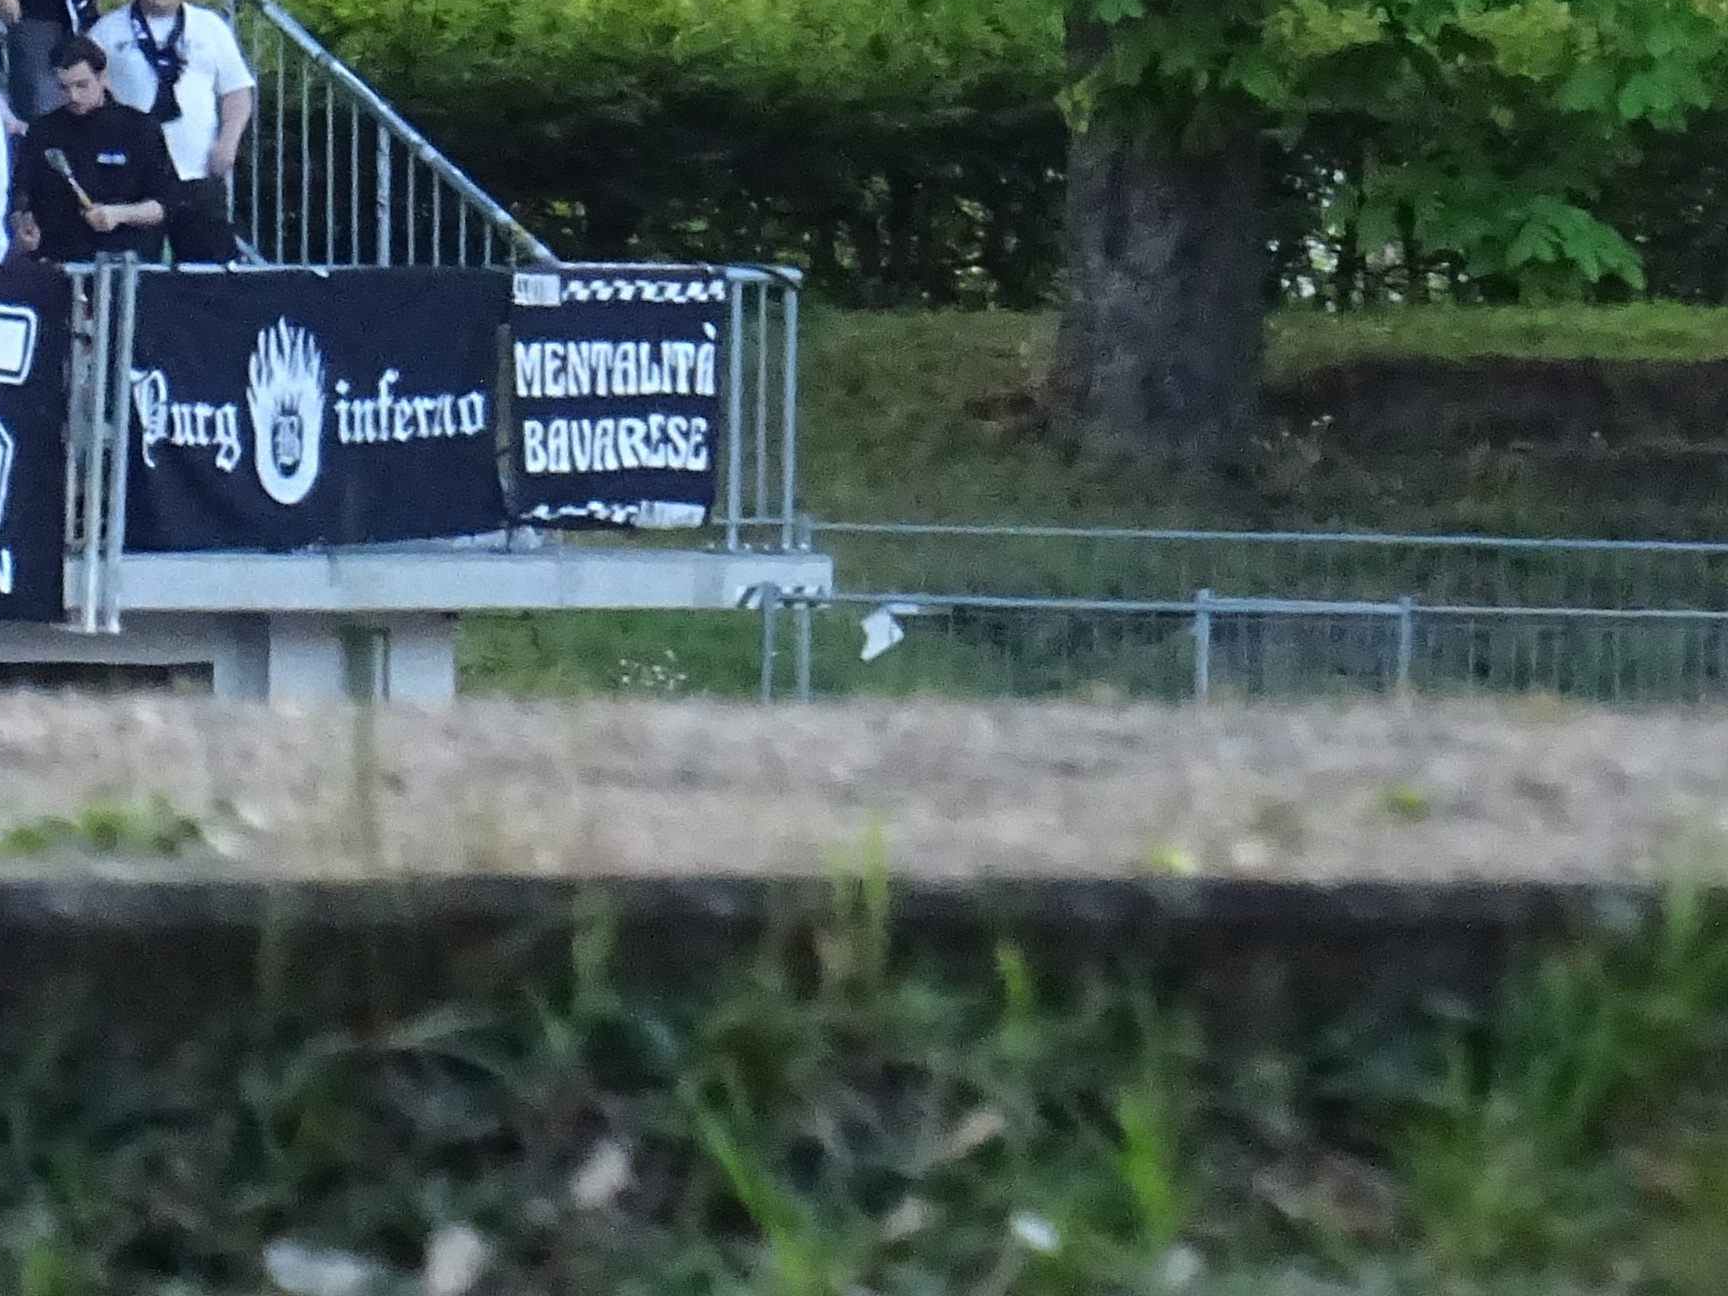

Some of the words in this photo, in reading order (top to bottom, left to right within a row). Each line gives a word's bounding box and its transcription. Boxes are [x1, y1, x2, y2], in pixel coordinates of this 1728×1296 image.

[513, 321, 718, 399] MENTALITÀ
[334, 368, 488, 444] inferno
[523, 412, 709, 474] BAVARESE
